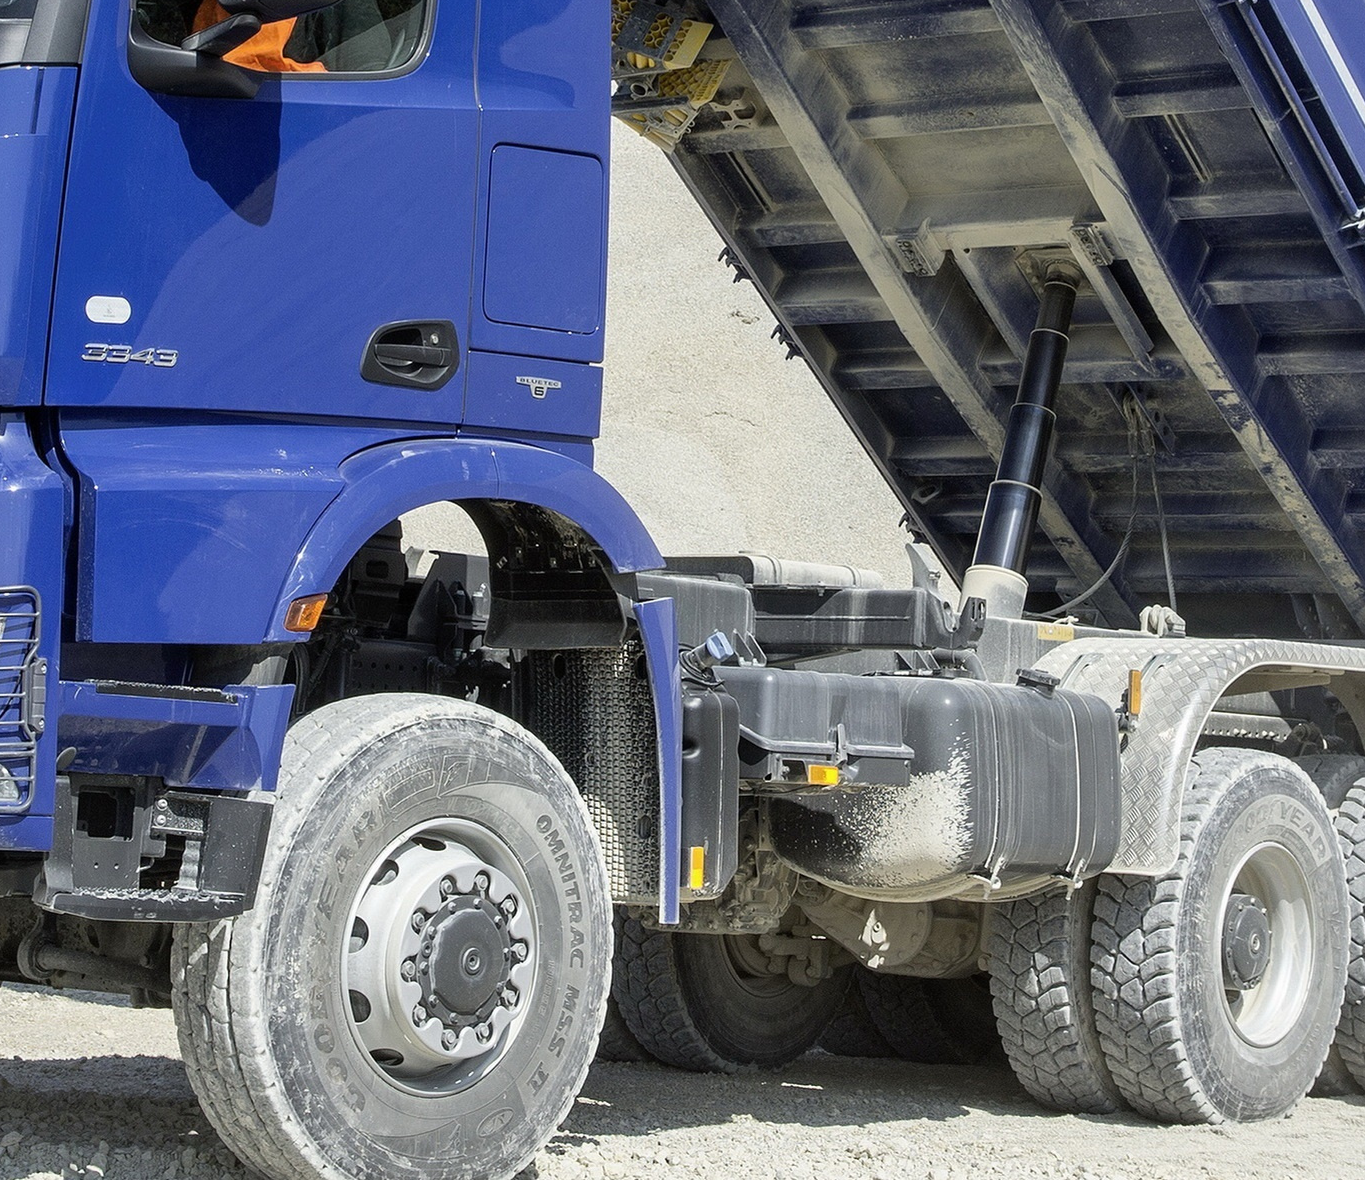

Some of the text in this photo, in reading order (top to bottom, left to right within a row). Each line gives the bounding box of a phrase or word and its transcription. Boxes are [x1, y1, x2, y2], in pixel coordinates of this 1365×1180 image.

[81, 343, 178, 367] 3343
[519, 377, 559, 387] BLUETEC
[535, 386, 544, 396] 6
[537, 814, 584, 969] OMNITRAC
